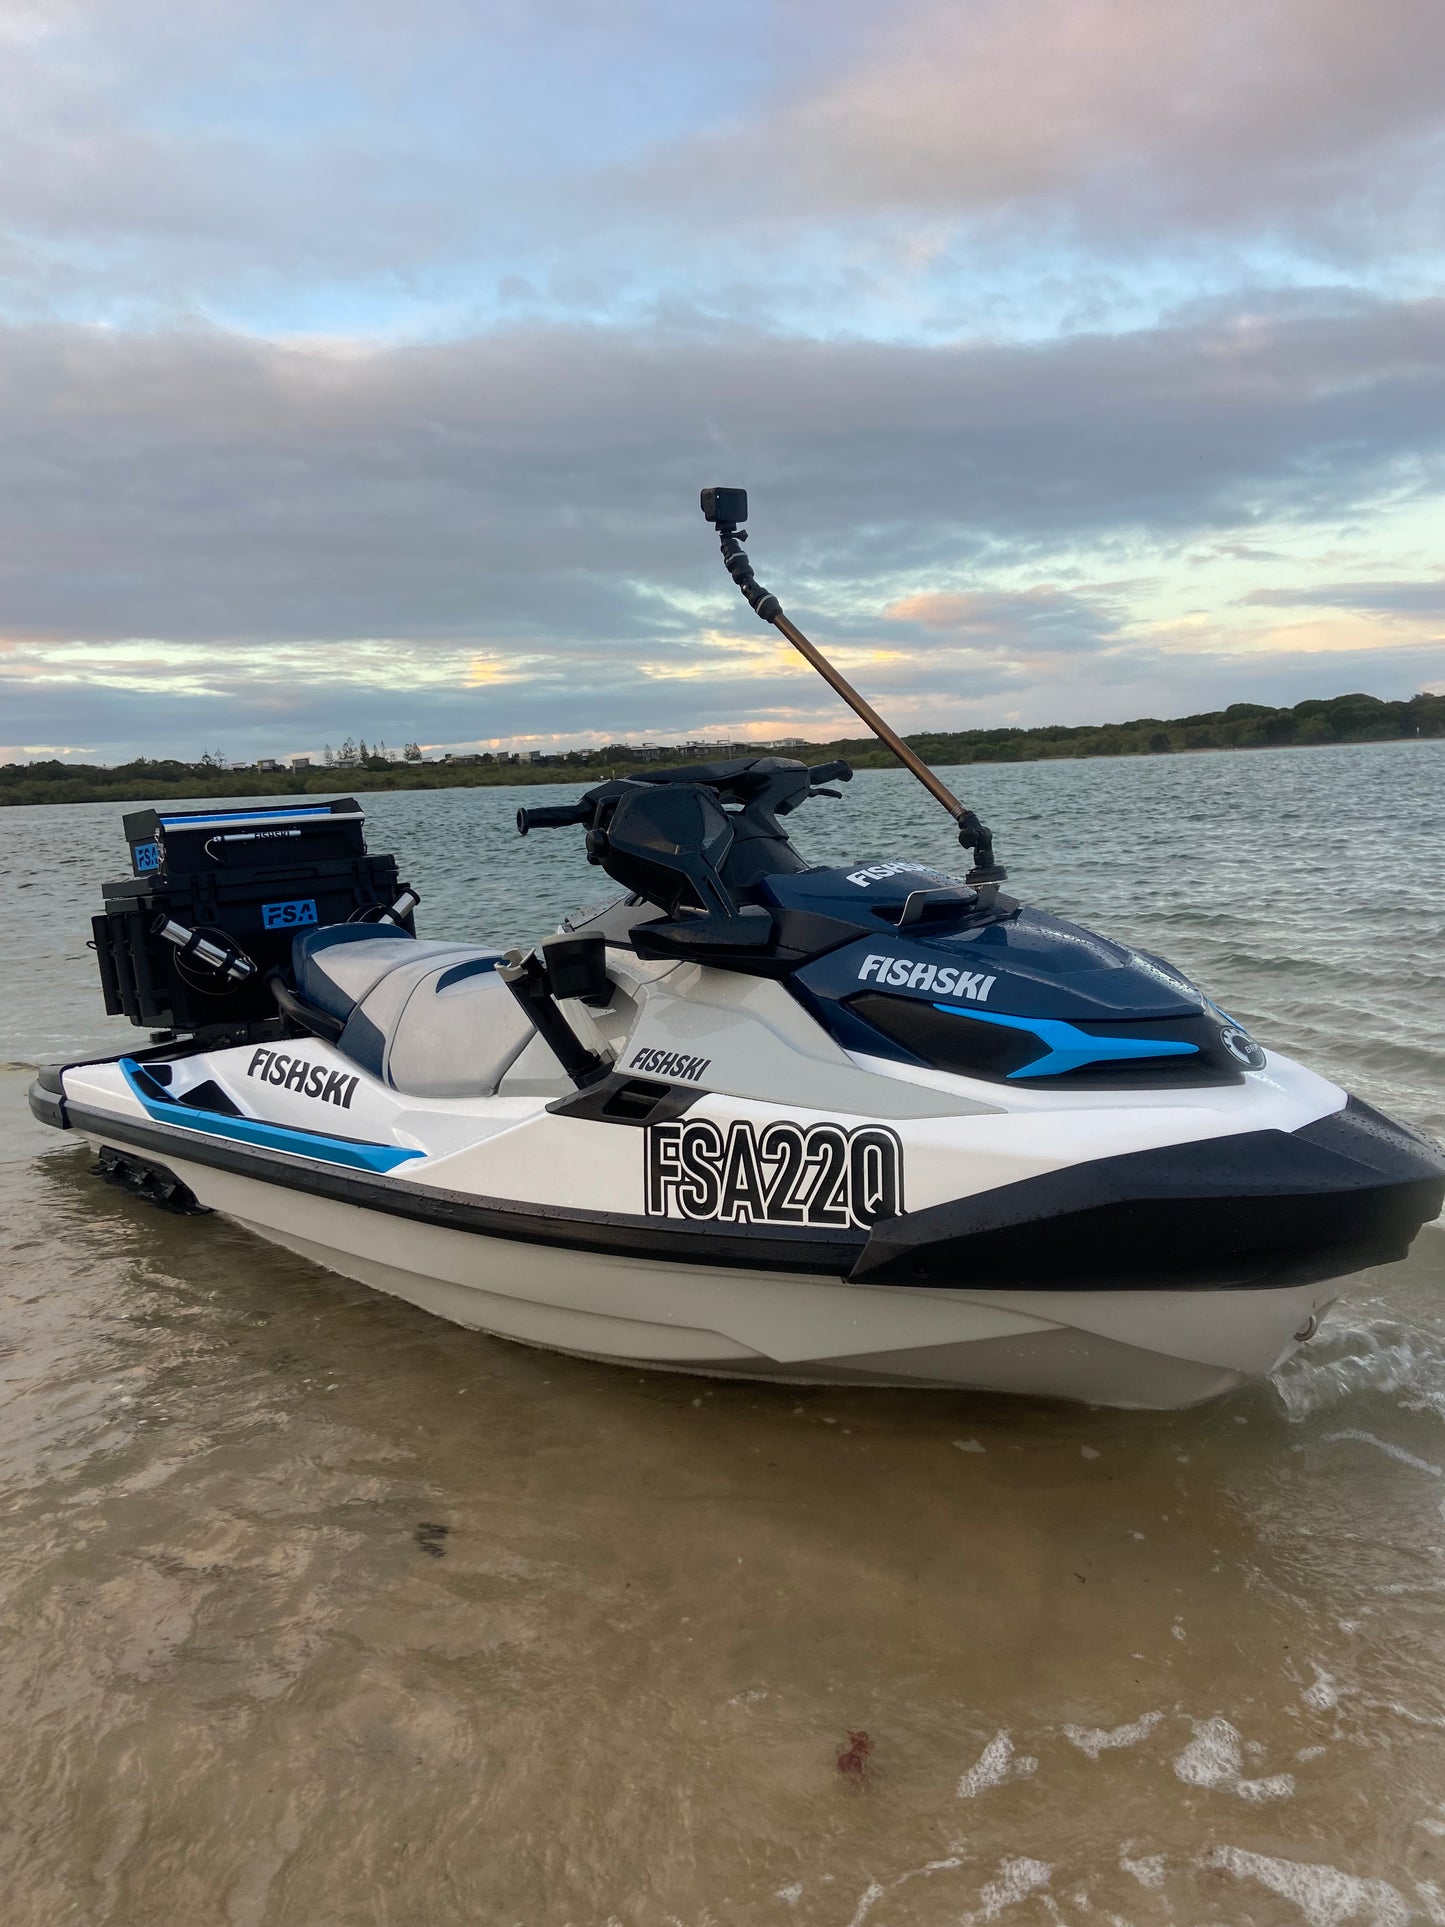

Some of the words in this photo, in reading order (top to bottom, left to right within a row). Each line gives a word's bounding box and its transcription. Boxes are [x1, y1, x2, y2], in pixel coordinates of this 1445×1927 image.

[138, 847, 159, 867] FSA
[845, 862, 929, 888] FISH
[268, 903, 314, 925] FSA
[857, 954, 997, 1002] FISHSKI
[247, 1048, 360, 1109] FISHSKI
[629, 1047, 712, 1082] FISHSKI
[644, 1118, 909, 1231] FSA22Q
